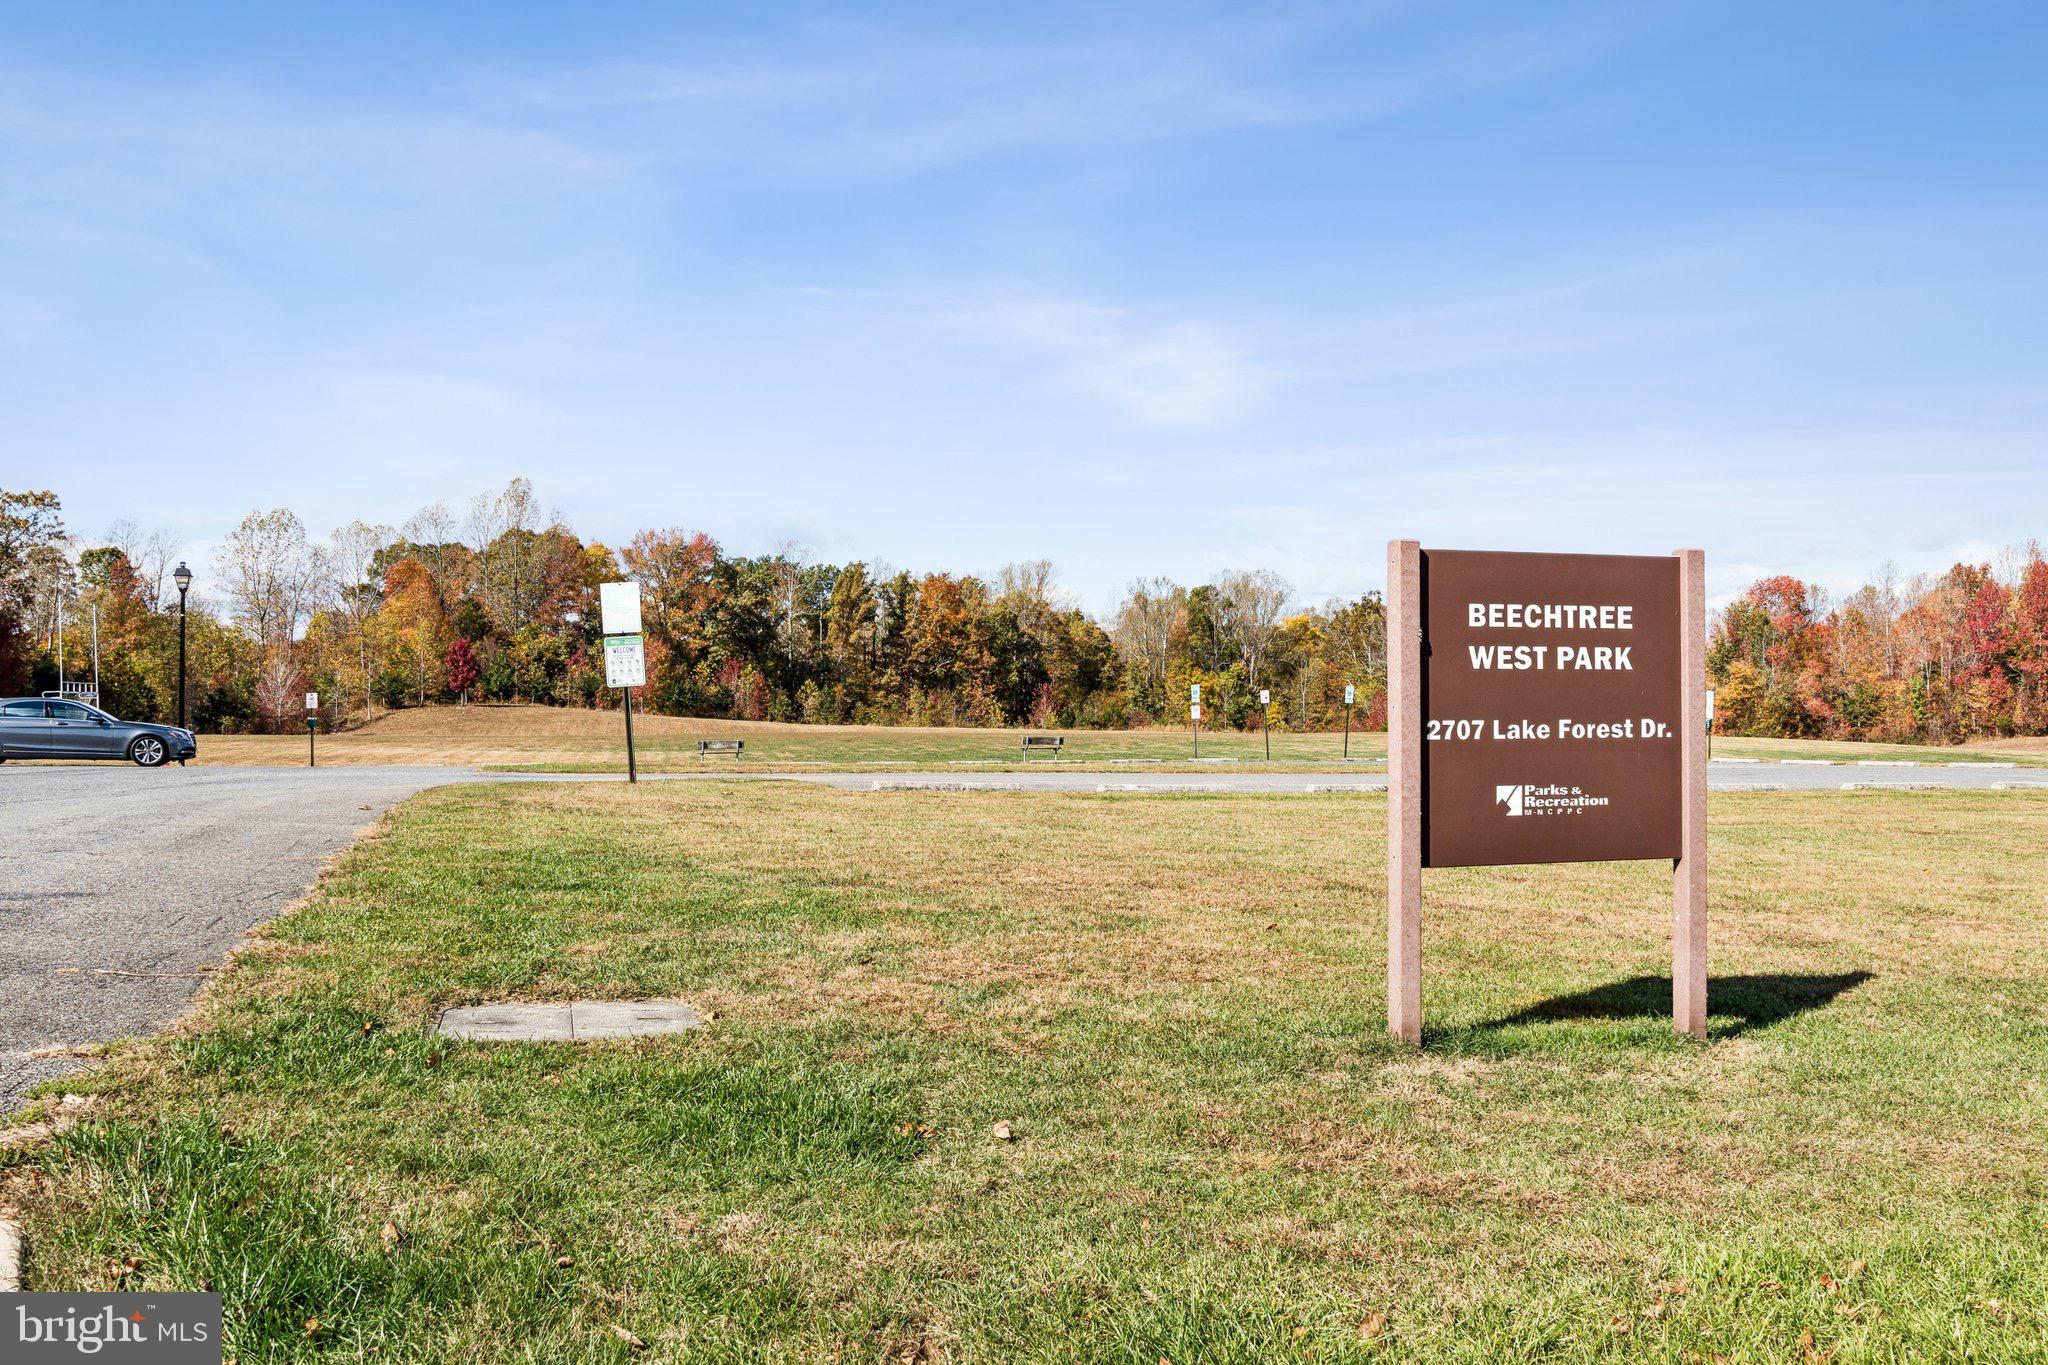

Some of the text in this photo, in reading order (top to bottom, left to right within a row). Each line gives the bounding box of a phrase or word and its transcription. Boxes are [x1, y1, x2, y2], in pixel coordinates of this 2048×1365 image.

[1468, 603, 1633, 629] BEECHTREE
[612, 646, 637, 654] WELCOME
[1468, 645, 1633, 670] WEST PARK
[1426, 718, 1672, 740] 2707 Lake Forest Dr.
[1524, 784, 1582, 796] Parks &
[1524, 794, 1609, 807] Recreation
